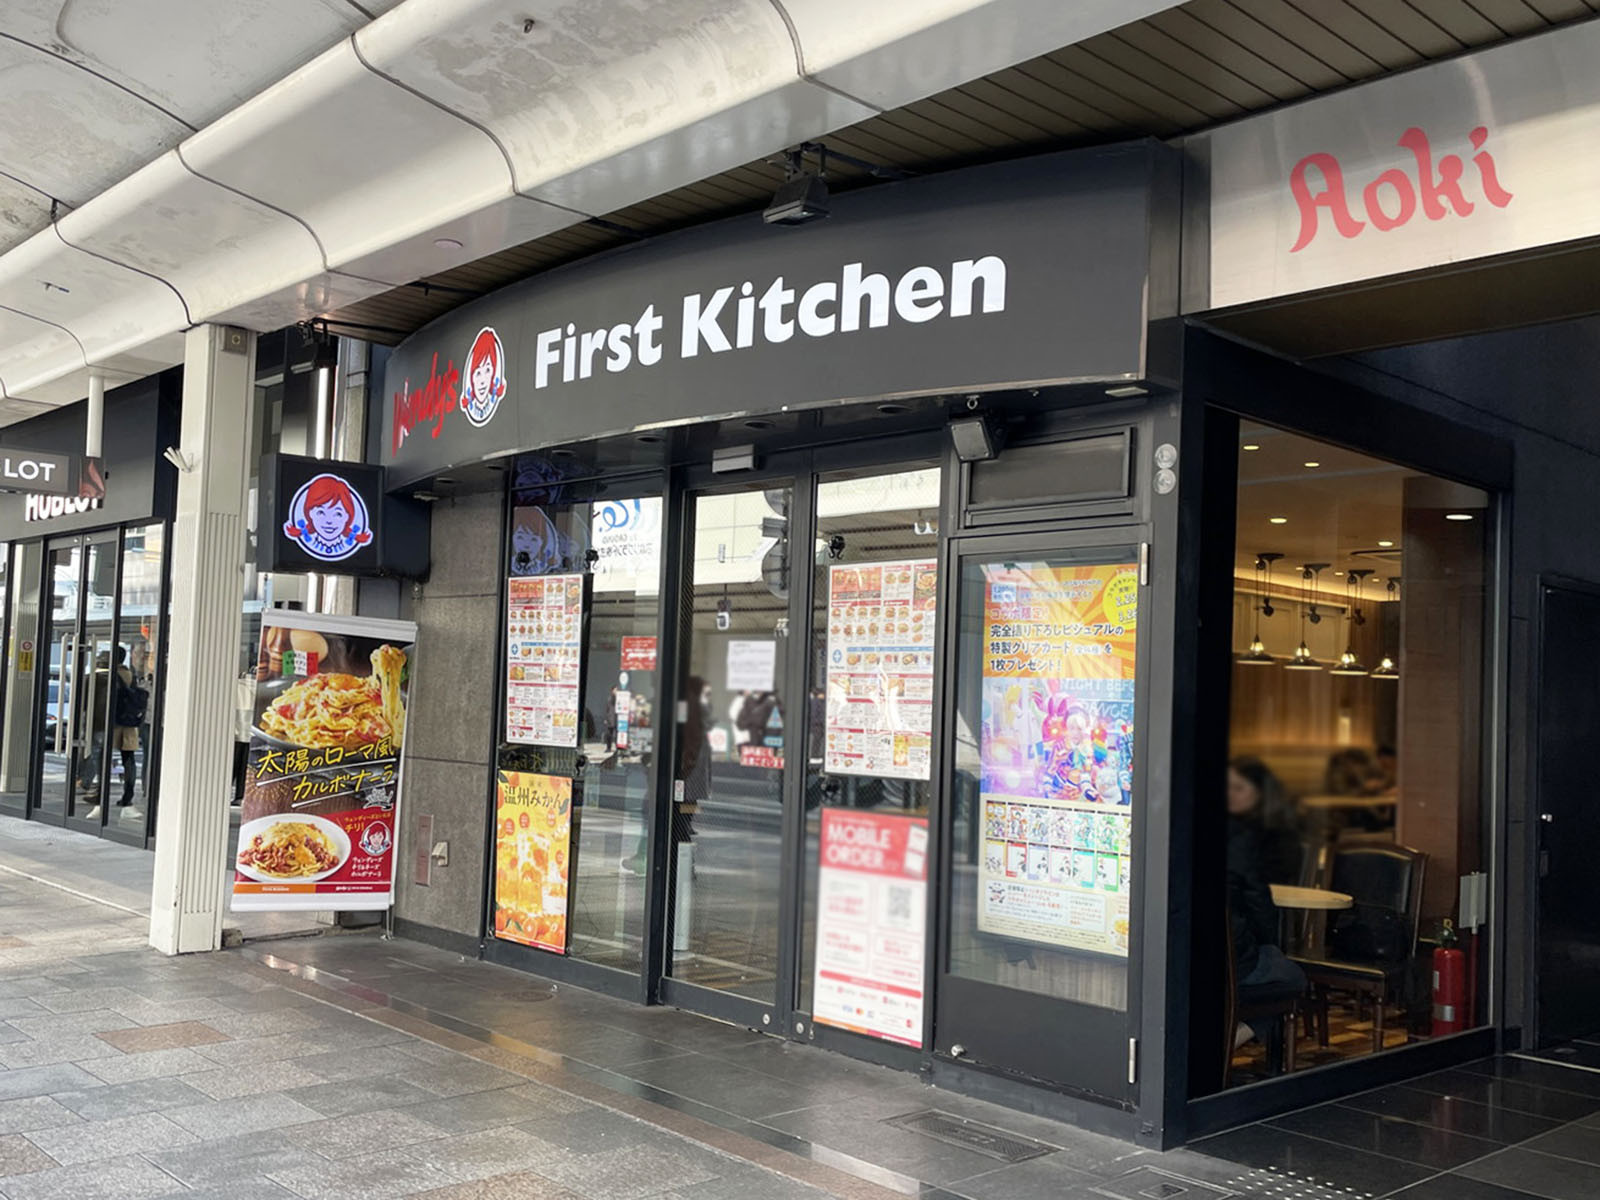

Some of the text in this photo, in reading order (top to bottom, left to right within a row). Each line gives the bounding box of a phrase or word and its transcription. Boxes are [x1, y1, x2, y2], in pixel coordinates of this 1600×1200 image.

[1289, 125, 1514, 253] Aoki
[535, 303, 663, 389] First
[680, 255, 1007, 359] Kitchen
[4, 458, 56, 482] LOT
[256, 736, 395, 779] 太陽のローマ風
[292, 764, 393, 801] カルボナーラ
[827, 823, 892, 850] MOBILE
[826, 844, 884, 869] ORDER
